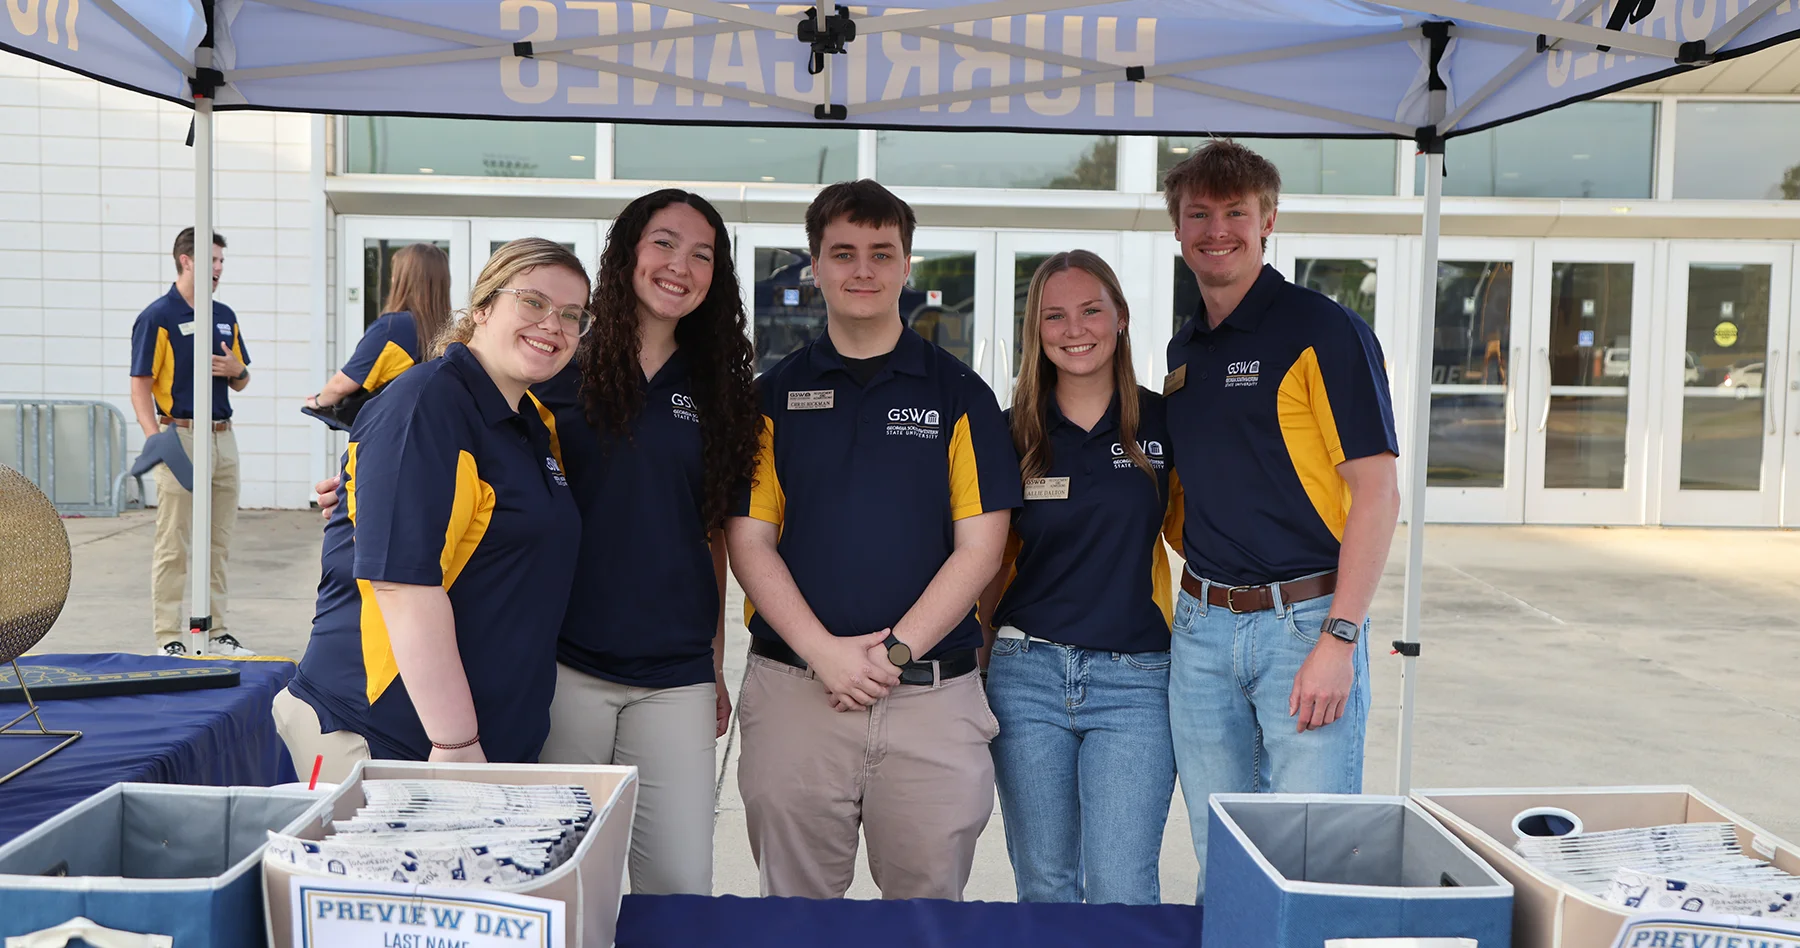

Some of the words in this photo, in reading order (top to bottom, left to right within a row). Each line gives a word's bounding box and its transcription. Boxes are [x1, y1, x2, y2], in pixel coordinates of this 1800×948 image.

[1228, 361, 1252, 375] GSW
[888, 408, 926, 424] GSW
[905, 430, 939, 439] UNIVERSITY
[316, 900, 466, 930] PREVIEW
[475, 913, 534, 940] DAY
[384, 932, 421, 948] LAST
